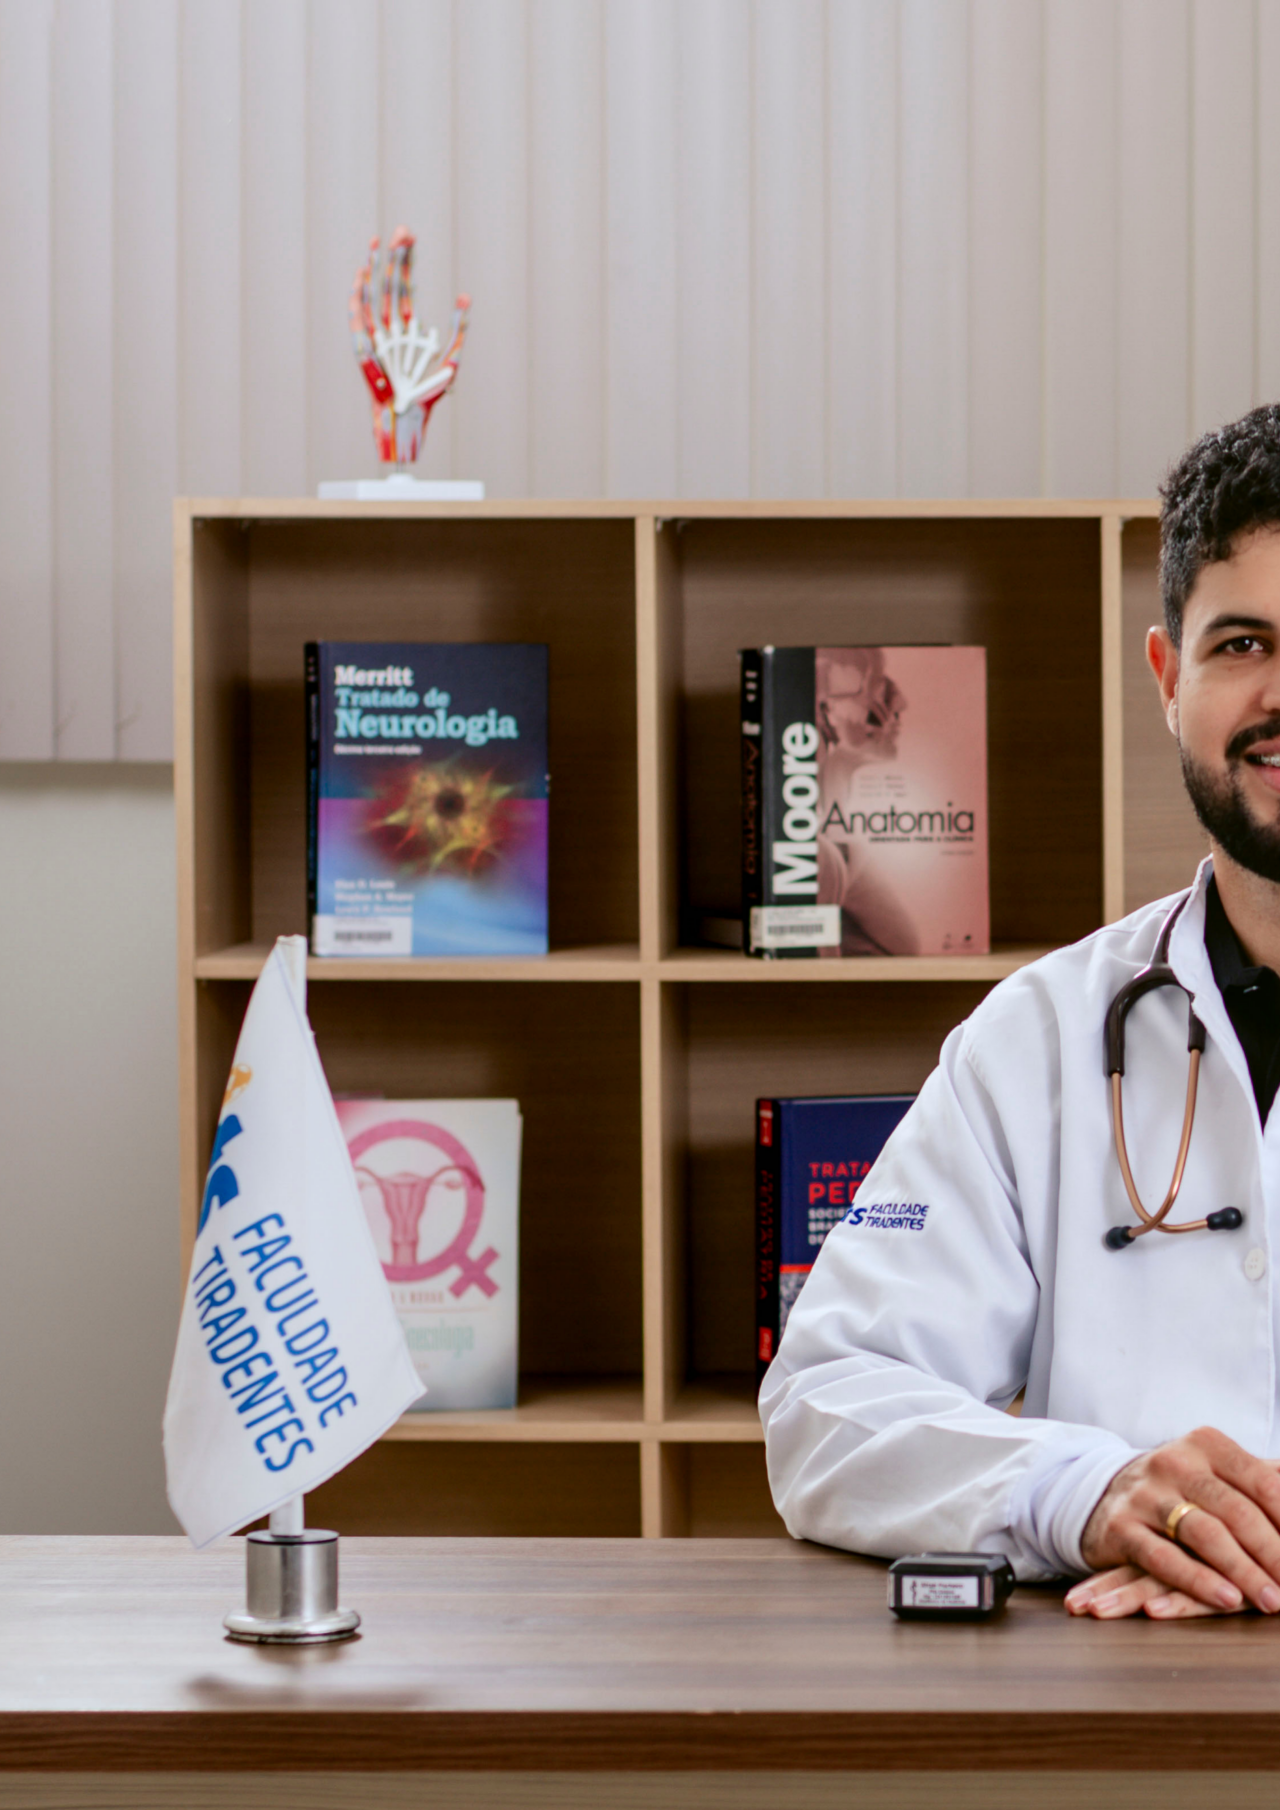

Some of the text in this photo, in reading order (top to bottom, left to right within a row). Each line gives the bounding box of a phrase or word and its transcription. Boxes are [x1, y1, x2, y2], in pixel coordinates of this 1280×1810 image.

[334, 665, 414, 687] Merritt
[334, 687, 450, 709] Tratado de
[335, 708, 518, 746] Neurologia
[772, 721, 819, 896] Moore
[822, 801, 974, 835] Anatomia
[865, 1216, 924, 1231] TIRADENTES
[869, 1203, 929, 1217] FACULDADE
[233, 1212, 357, 1429] FACULDADE
[191, 1244, 315, 1473] TIRADENTES
